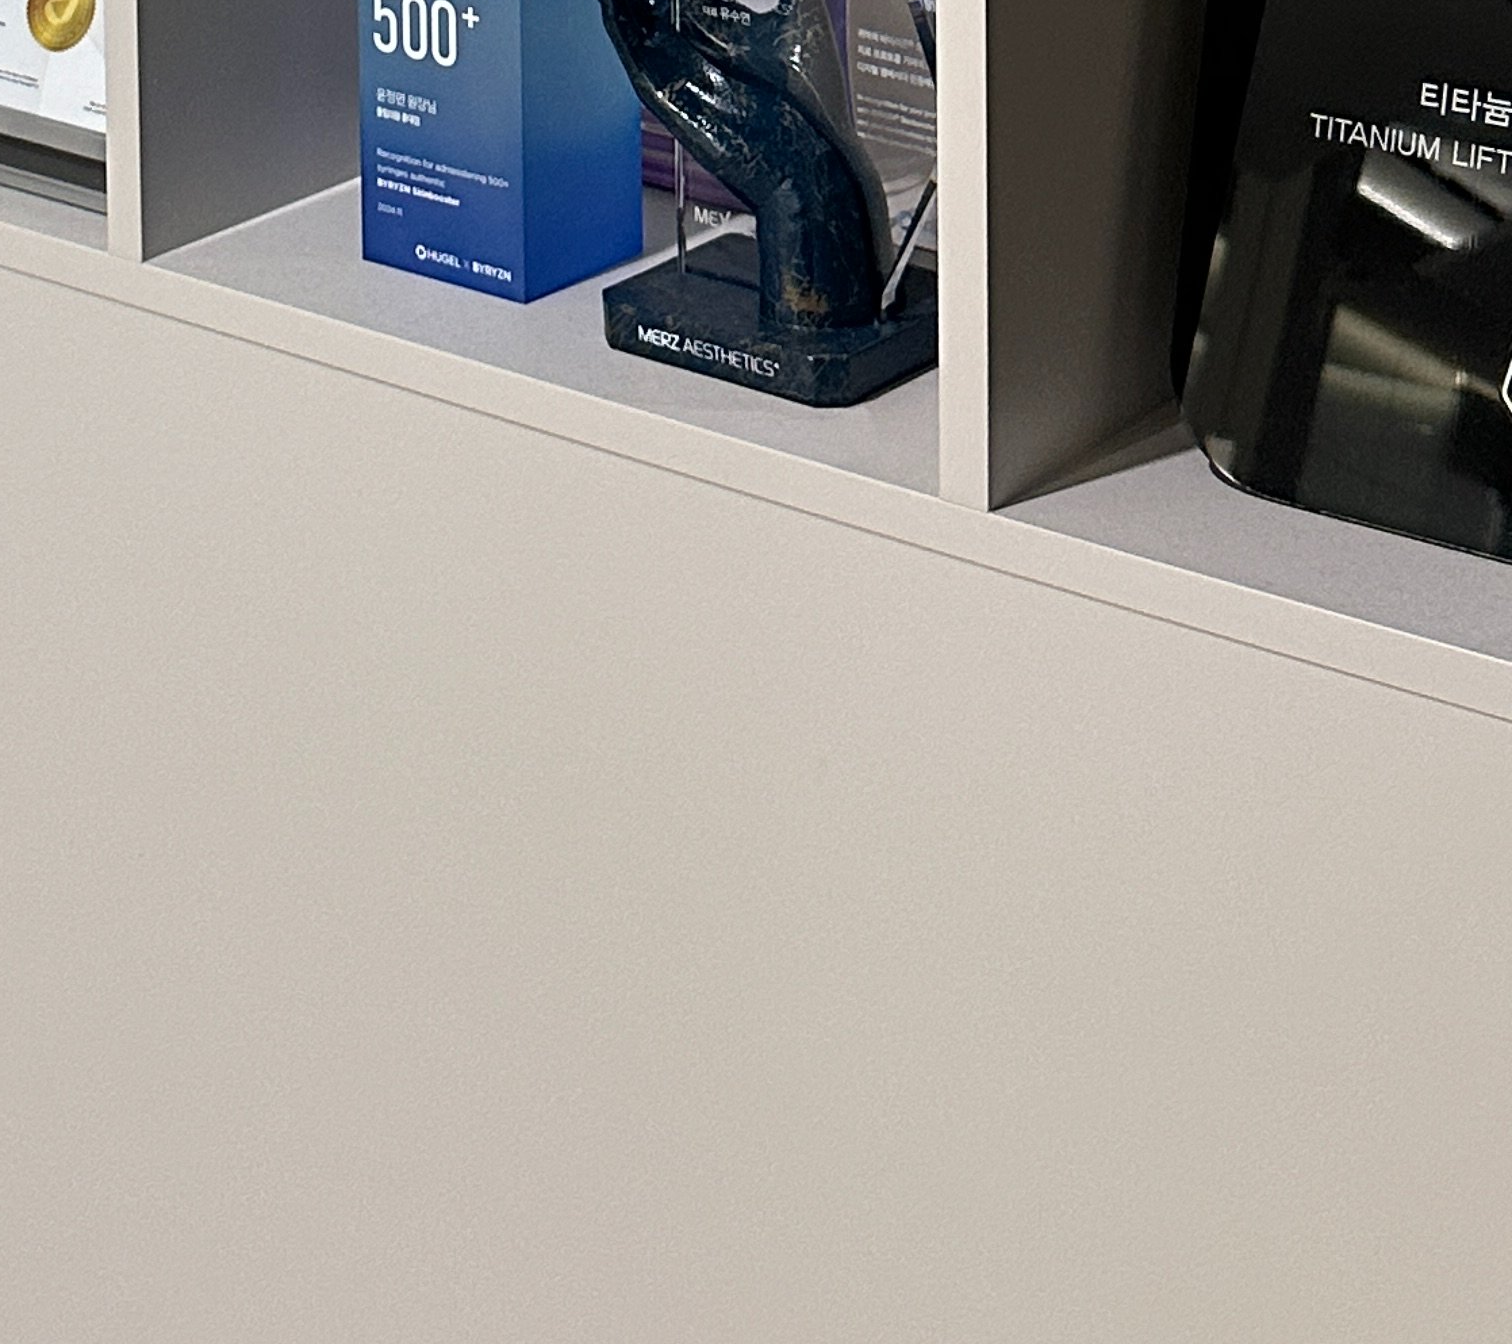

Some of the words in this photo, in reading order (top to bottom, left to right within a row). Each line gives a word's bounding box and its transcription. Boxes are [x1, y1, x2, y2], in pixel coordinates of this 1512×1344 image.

[1419, 82, 1512, 128] 티타늄
[1309, 111, 1441, 163] TITANIUM
[637, 325, 681, 352] MERZ
[682, 338, 776, 378] AESTHETICS
